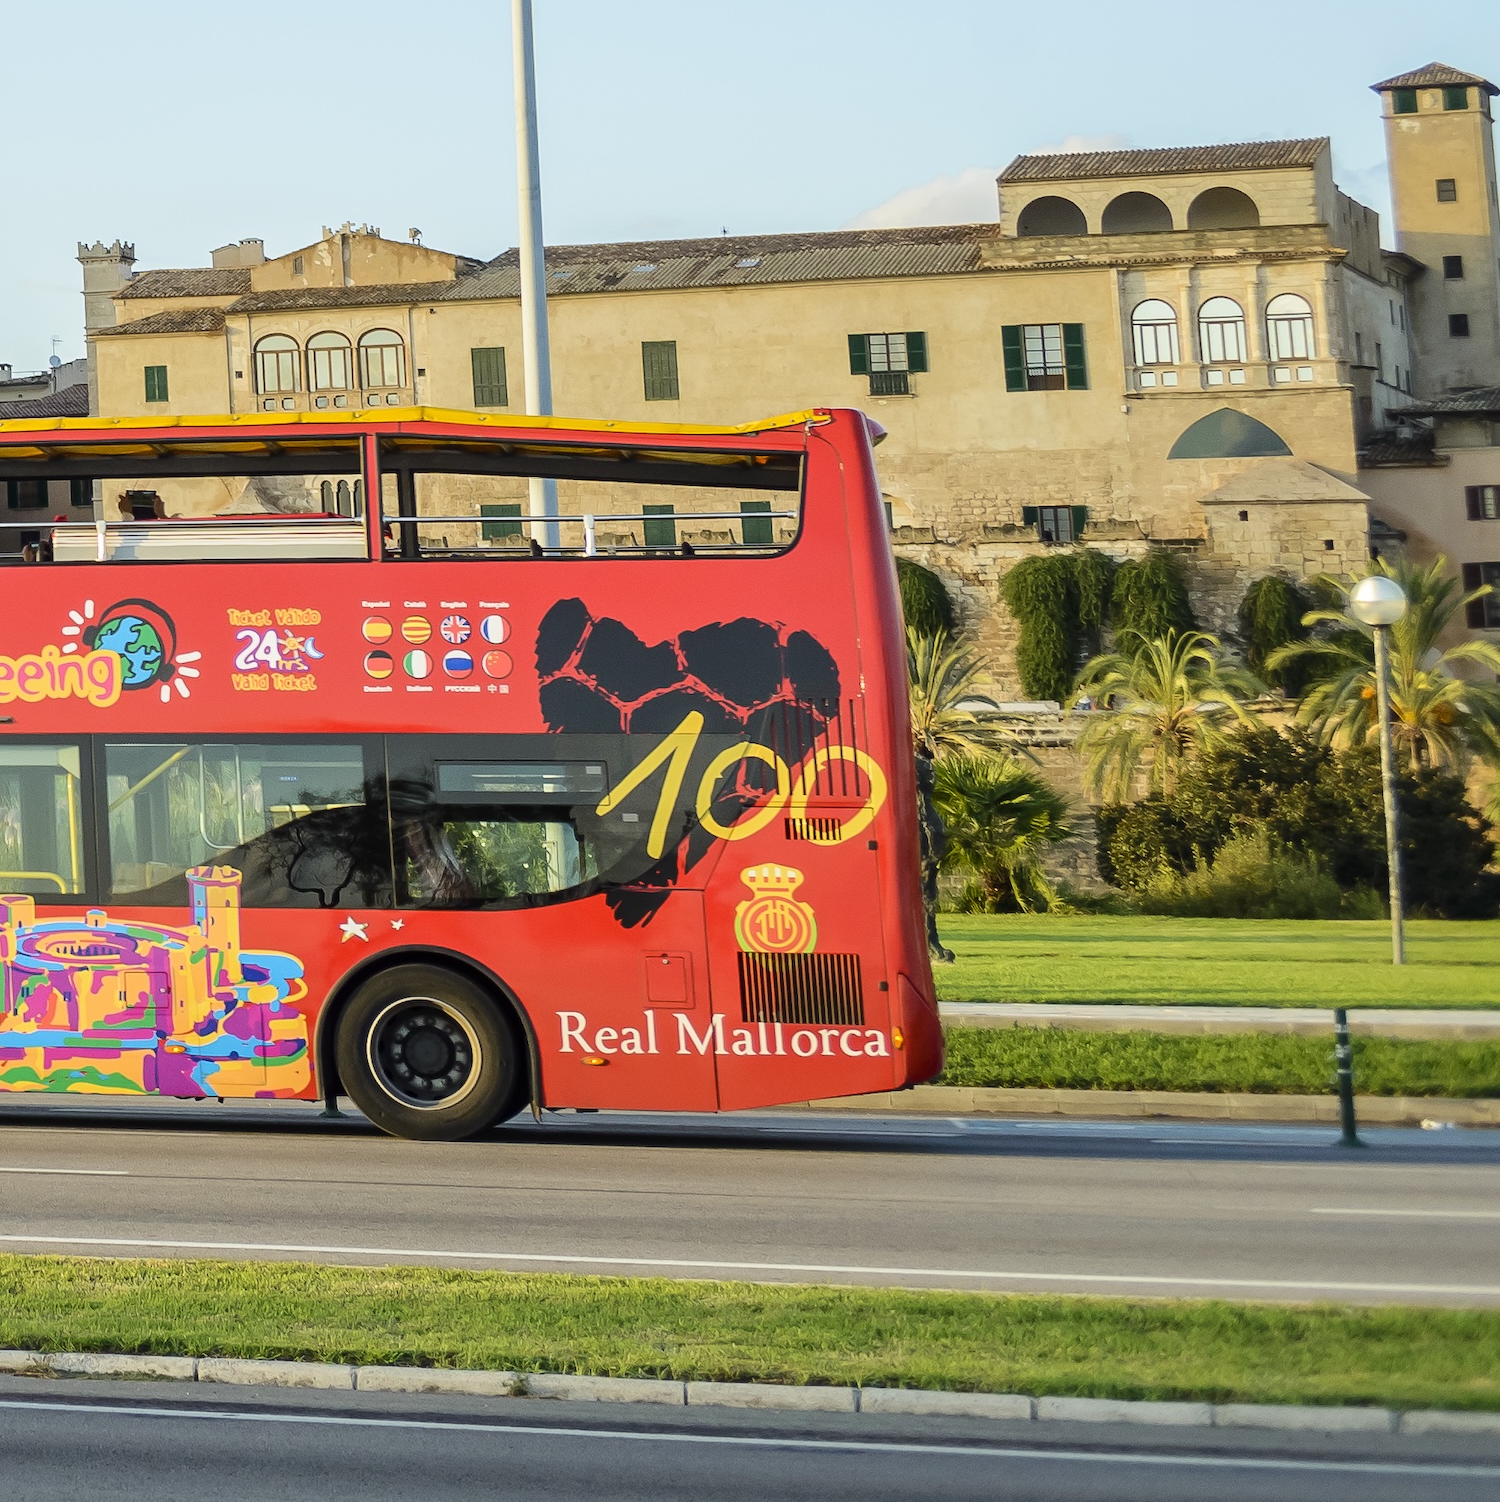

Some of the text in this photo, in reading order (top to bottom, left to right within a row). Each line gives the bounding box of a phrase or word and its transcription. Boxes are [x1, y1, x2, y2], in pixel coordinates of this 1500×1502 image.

[227, 608, 272, 626] Ticket
[235, 629, 281, 670] 24
[231, 672, 317, 691] Valid Ticket
[595, 710, 888, 859] 100
[555, 1009, 890, 1057] Real Mallorca
